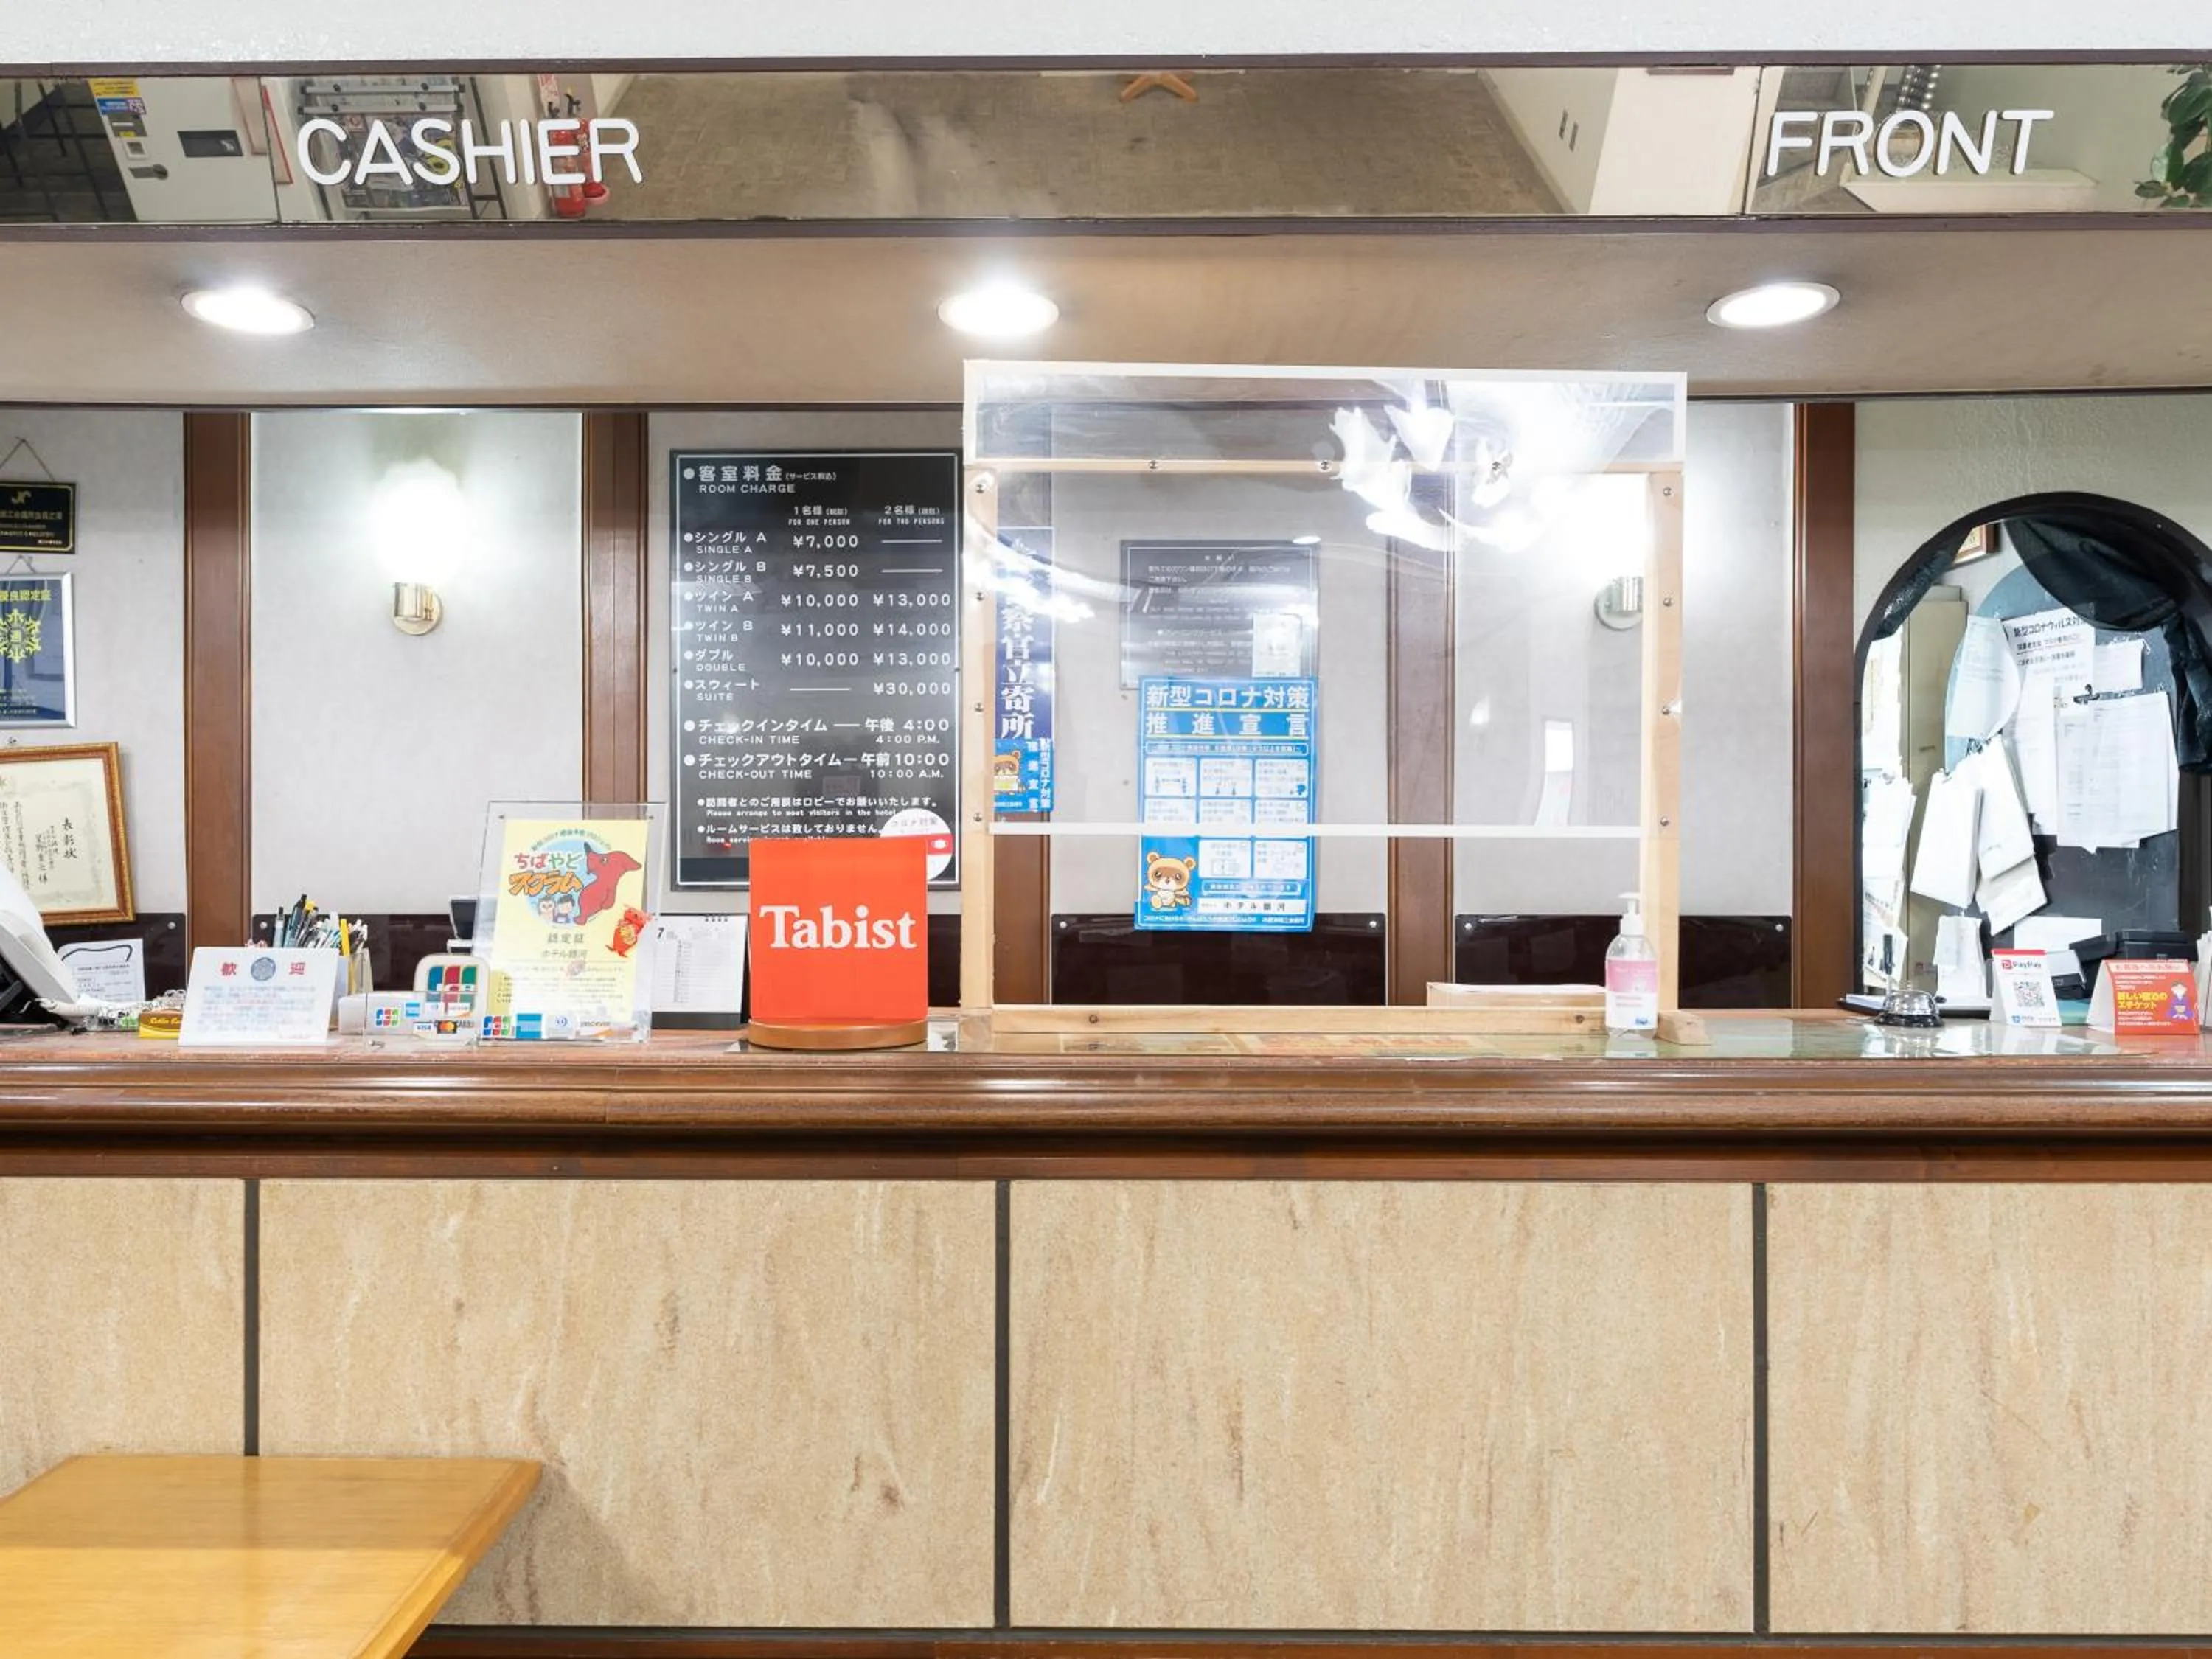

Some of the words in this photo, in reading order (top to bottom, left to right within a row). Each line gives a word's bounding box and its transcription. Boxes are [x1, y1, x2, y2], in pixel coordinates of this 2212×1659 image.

[297, 118, 643, 185] CASHIER
[1767, 109, 2055, 178] FRONT
[699, 465, 783, 482] 客室料金
[699, 484, 736, 493] ROOM
[740, 484, 796, 493] CHARGE
[695, 531, 747, 543] シングル
[756, 531, 768, 543] A
[793, 535, 859, 549] ¥7,000
[696, 546, 740, 554] SINGLE
[744, 546, 753, 554] A
[695, 560, 747, 573] シングル
[756, 561, 767, 572] B
[793, 565, 859, 579] ¥7,500
[696, 574, 740, 583] SINGLE
[744, 575, 752, 583] B
[695, 591, 733, 602] ツイン
[742, 591, 754, 602] A
[781, 594, 859, 608] ¥10,000
[873, 594, 951, 608] ¥13,000
[696, 605, 727, 613] TWIN
[731, 605, 739, 613] A
[695, 620, 733, 632] ツイン
[742, 620, 754, 631] B
[781, 623, 859, 637] ¥11,000
[873, 623, 951, 637] ¥14,000
[696, 633, 727, 642] TWIN
[731, 633, 738, 642] B
[695, 648, 734, 661] ダブル
[781, 653, 859, 667] ¥10,000
[873, 653, 951, 667] ¥13,000
[696, 663, 746, 672] DOUBLE
[695, 678, 761, 691] スウィート
[873, 682, 951, 696] ¥30,000
[696, 692, 734, 701] SUITE
[1146, 684, 1310, 709] 新型コロナ対策
[698, 718, 828, 733] チェックインタイム
[865, 717, 895, 732] 午後
[902, 718, 950, 731] 4:00
[1146, 712, 1310, 737] 推進宣言
[698, 735, 764, 745] CHECK-IN
[769, 735, 801, 745] TIME
[875, 734, 913, 744] 4:00
[917, 734, 941, 744] P.M.
[698, 752, 842, 767] チェックアウトタイム
[860, 751, 891, 767] 午前
[894, 752, 950, 766] 10:00
[698, 770, 776, 779] CHECK-OUT
[782, 770, 813, 779] TIME
[870, 769, 914, 778] 10:00
[918, 769, 945, 778] A.M.
[514, 852, 582, 869] ちばやど
[509, 870, 584, 897] スクラム
[759, 904, 917, 949] Tabist
